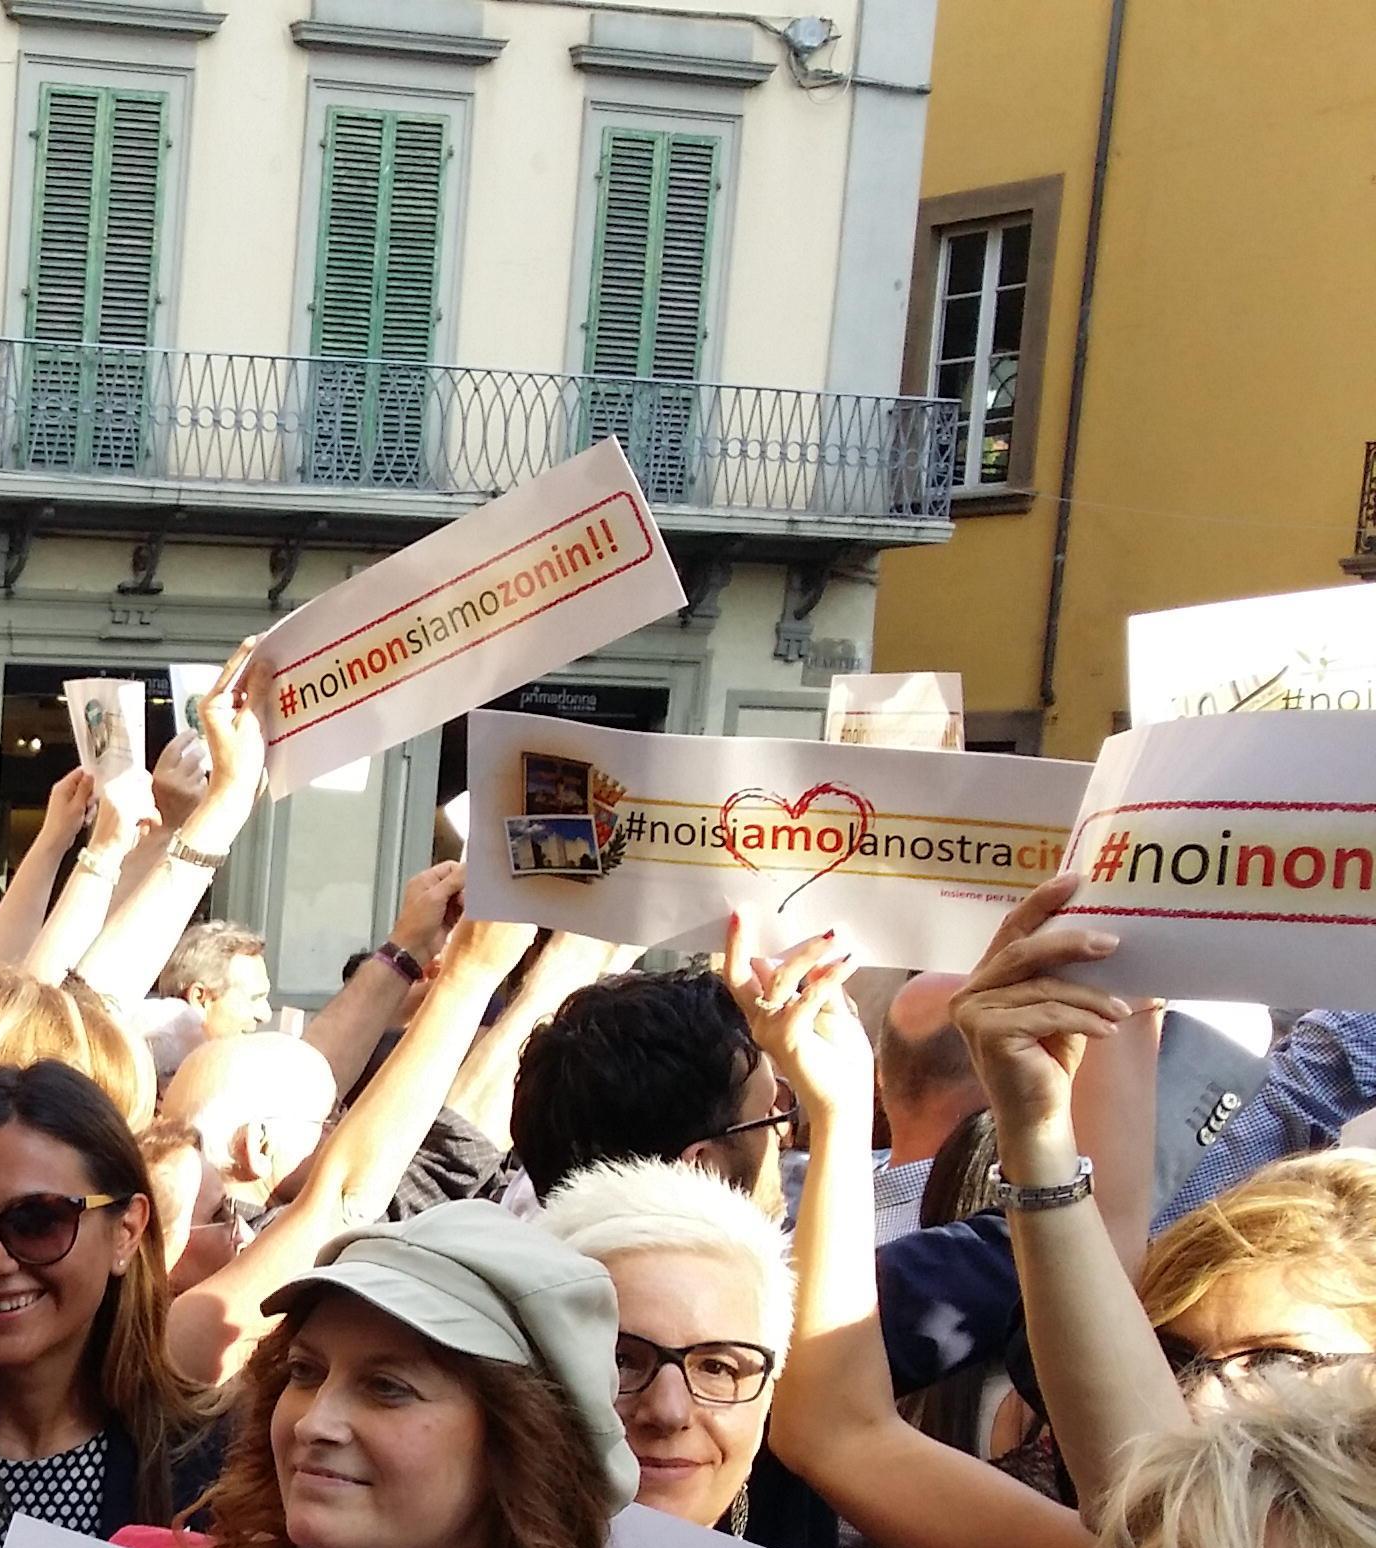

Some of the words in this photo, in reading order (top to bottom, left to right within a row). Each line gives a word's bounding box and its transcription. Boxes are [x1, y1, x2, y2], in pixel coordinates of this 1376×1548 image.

[279, 518, 619, 719] #noinonsiamozonin!!
[520, 686, 597, 708] primadonna
[1091, 830, 1375, 890] #noinon
